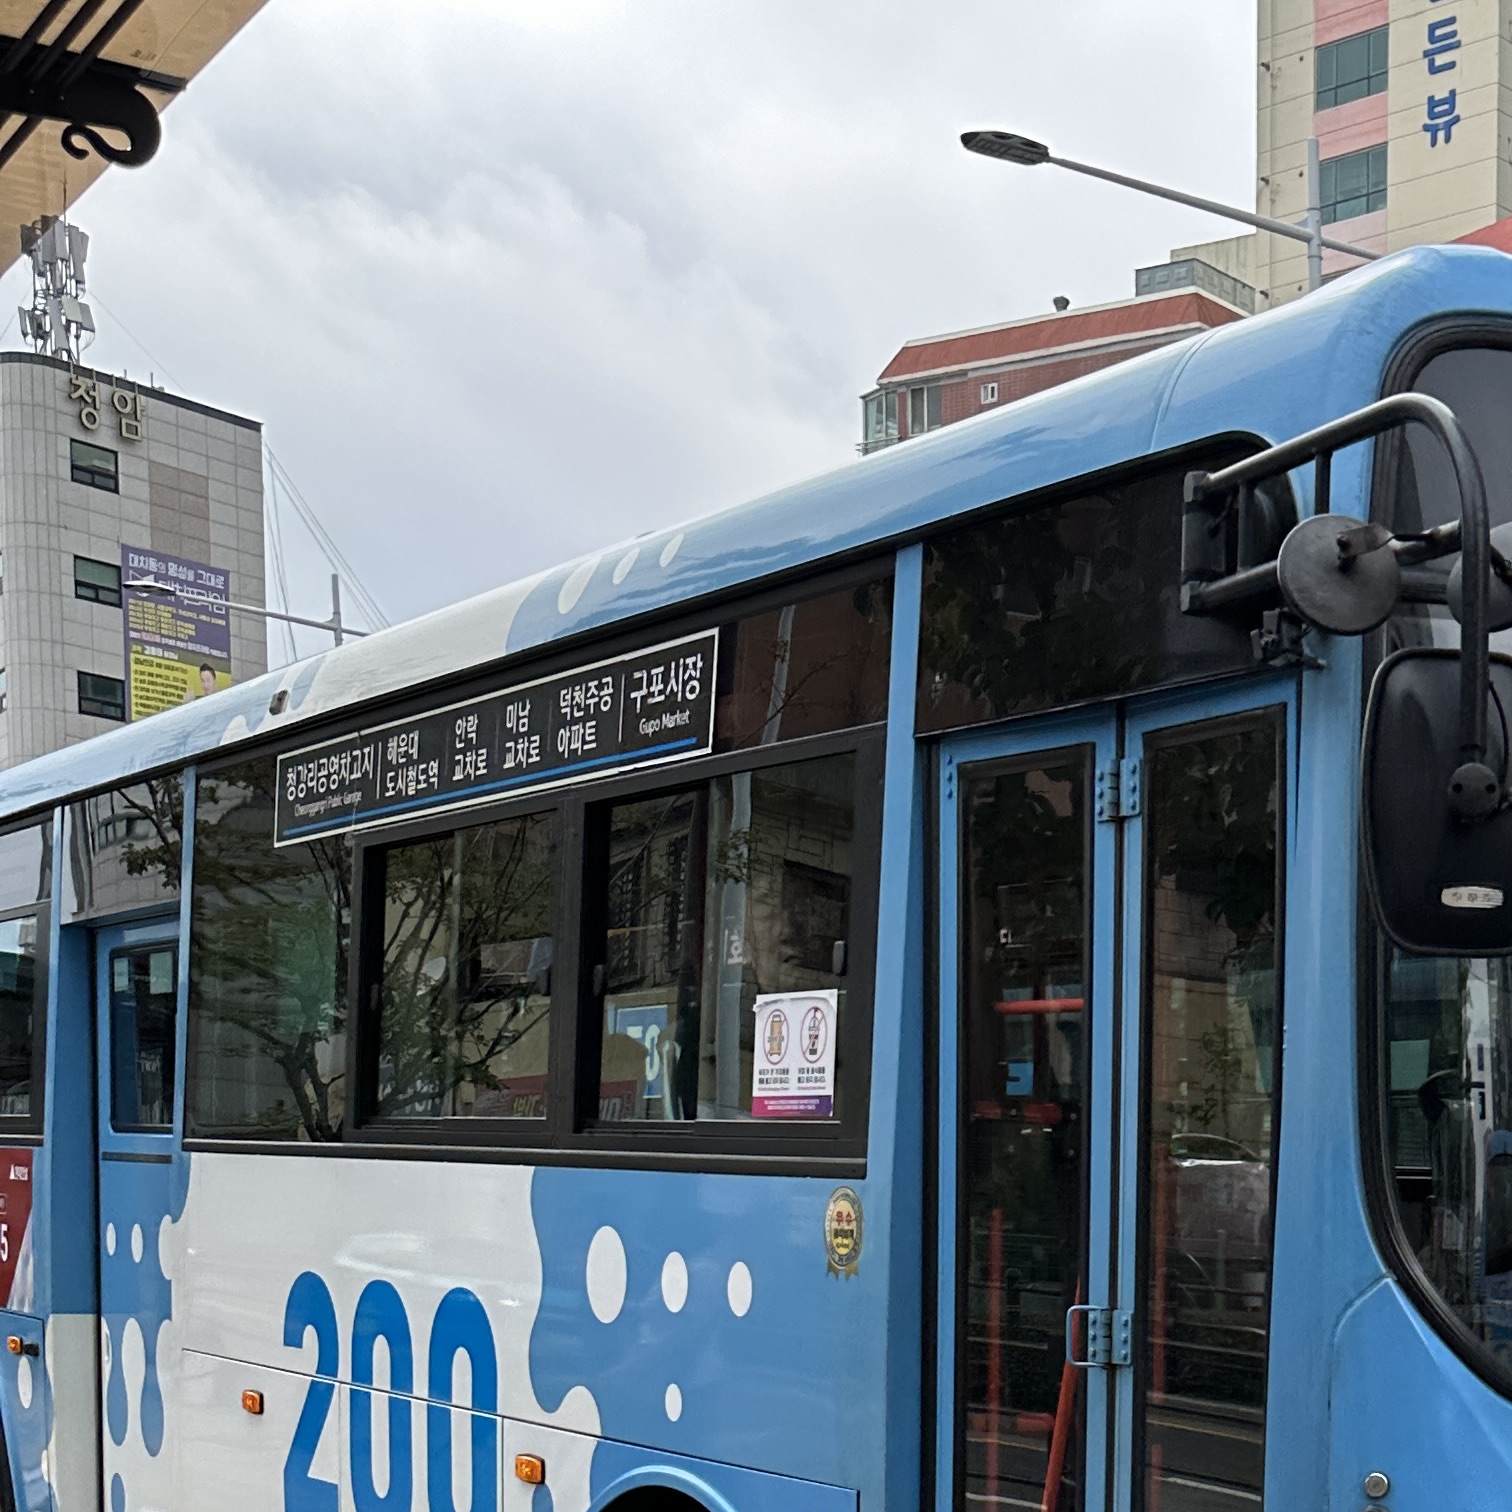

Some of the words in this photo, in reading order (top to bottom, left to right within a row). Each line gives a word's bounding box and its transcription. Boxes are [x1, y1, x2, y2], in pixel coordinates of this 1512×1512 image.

[1422, 0, 1462, 148] 든뷰
[559, 676, 614, 721] 덕천주공
[630, 653, 704, 714] 구포시장
[455, 713, 479, 748] 안락
[506, 698, 531, 734] 미남
[639, 717, 661, 738] Gupo
[661, 709, 690, 730] Market
[386, 729, 420, 765] 해운대
[503, 734, 541, 769] 교차로
[557, 720, 597, 759] 아파트
[286, 744, 375, 801] 청강리공영차고지
[385, 758, 439, 797] 도시철도역
[452, 748, 488, 781] 교차로
